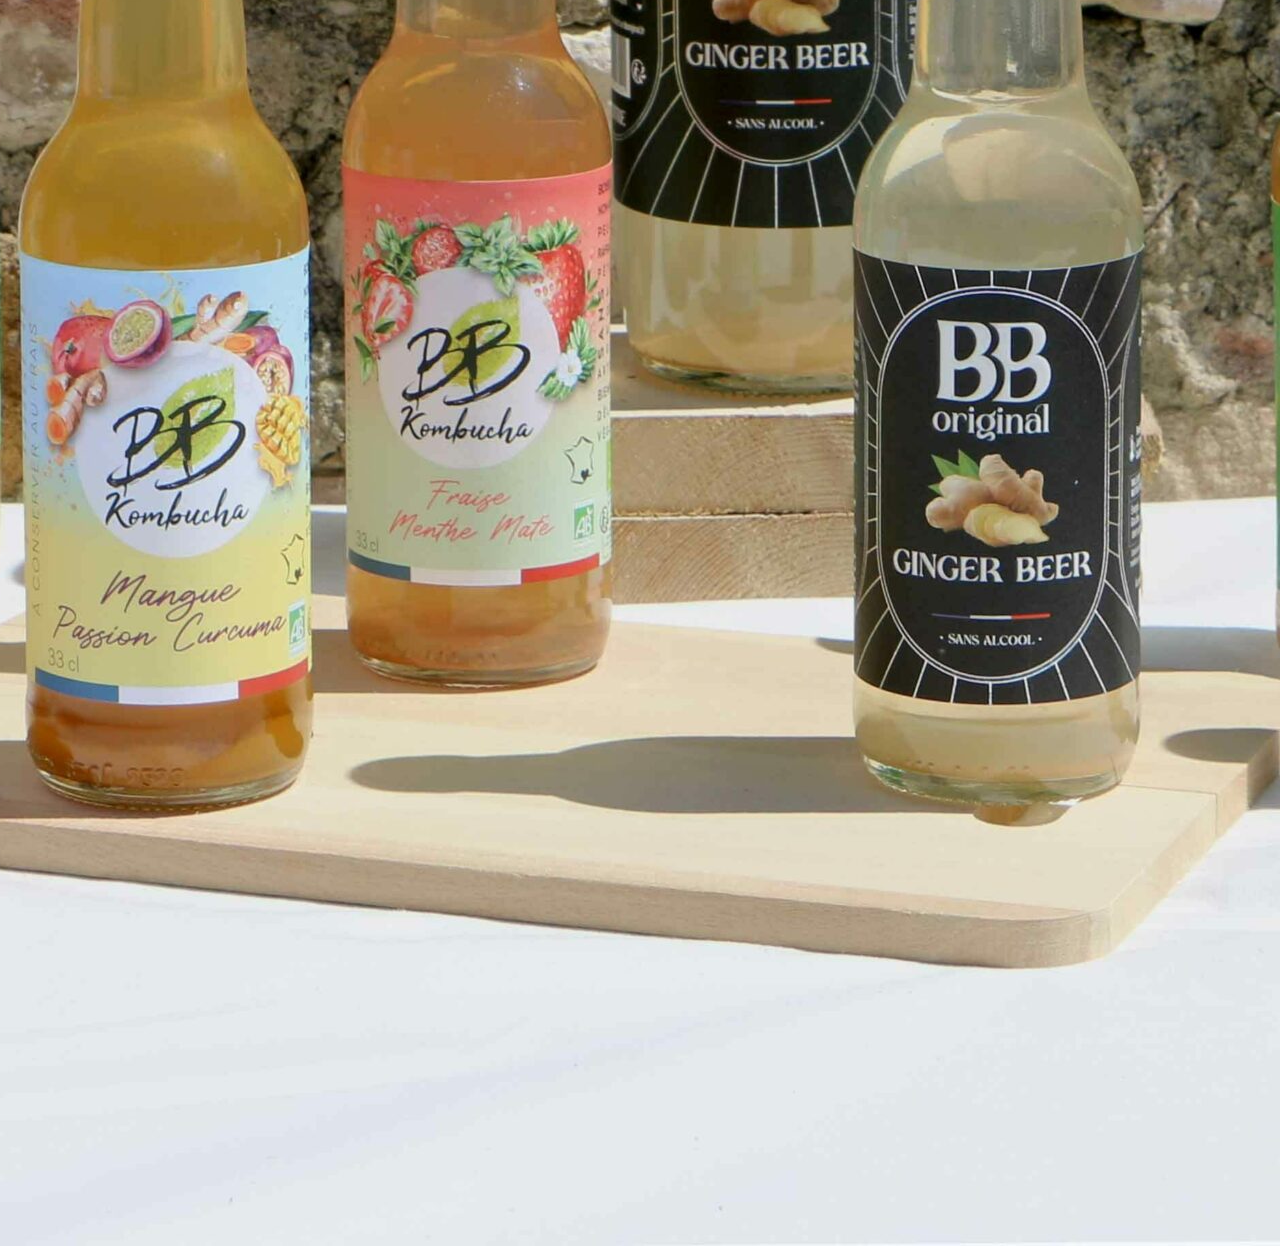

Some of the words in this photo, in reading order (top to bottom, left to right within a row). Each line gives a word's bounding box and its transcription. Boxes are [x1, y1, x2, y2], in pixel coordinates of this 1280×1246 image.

[685, 42, 790, 70] GINGER
[796, 42, 871, 70] BEER
[735, 118, 766, 130] SANS
[769, 117, 819, 131] ALCOOL
[401, 319, 531, 409] BB
[936, 319, 1052, 403] BB
[30, 405, 40, 435] AU
[400, 405, 535, 444] Kombucha
[106, 394, 246, 496] BB
[105, 487, 250, 531] Kombucha
[427, 480, 512, 513] Fraise
[31, 444, 41, 591] CONSERVER
[388, 510, 479, 542] Menthe
[356, 530, 368, 549] 33
[892, 548, 1004, 583] GINGER
[1016, 551, 1092, 583] BEER
[100, 570, 242, 622] Mangue
[52, 605, 157, 648] Passion
[173, 613, 288, 653] Curcuma
[948, 633, 980, 646] SANS
[983, 633, 1035, 647] ALCOOL
[48, 648, 65, 669] 33
[68, 657, 79, 673] cl
